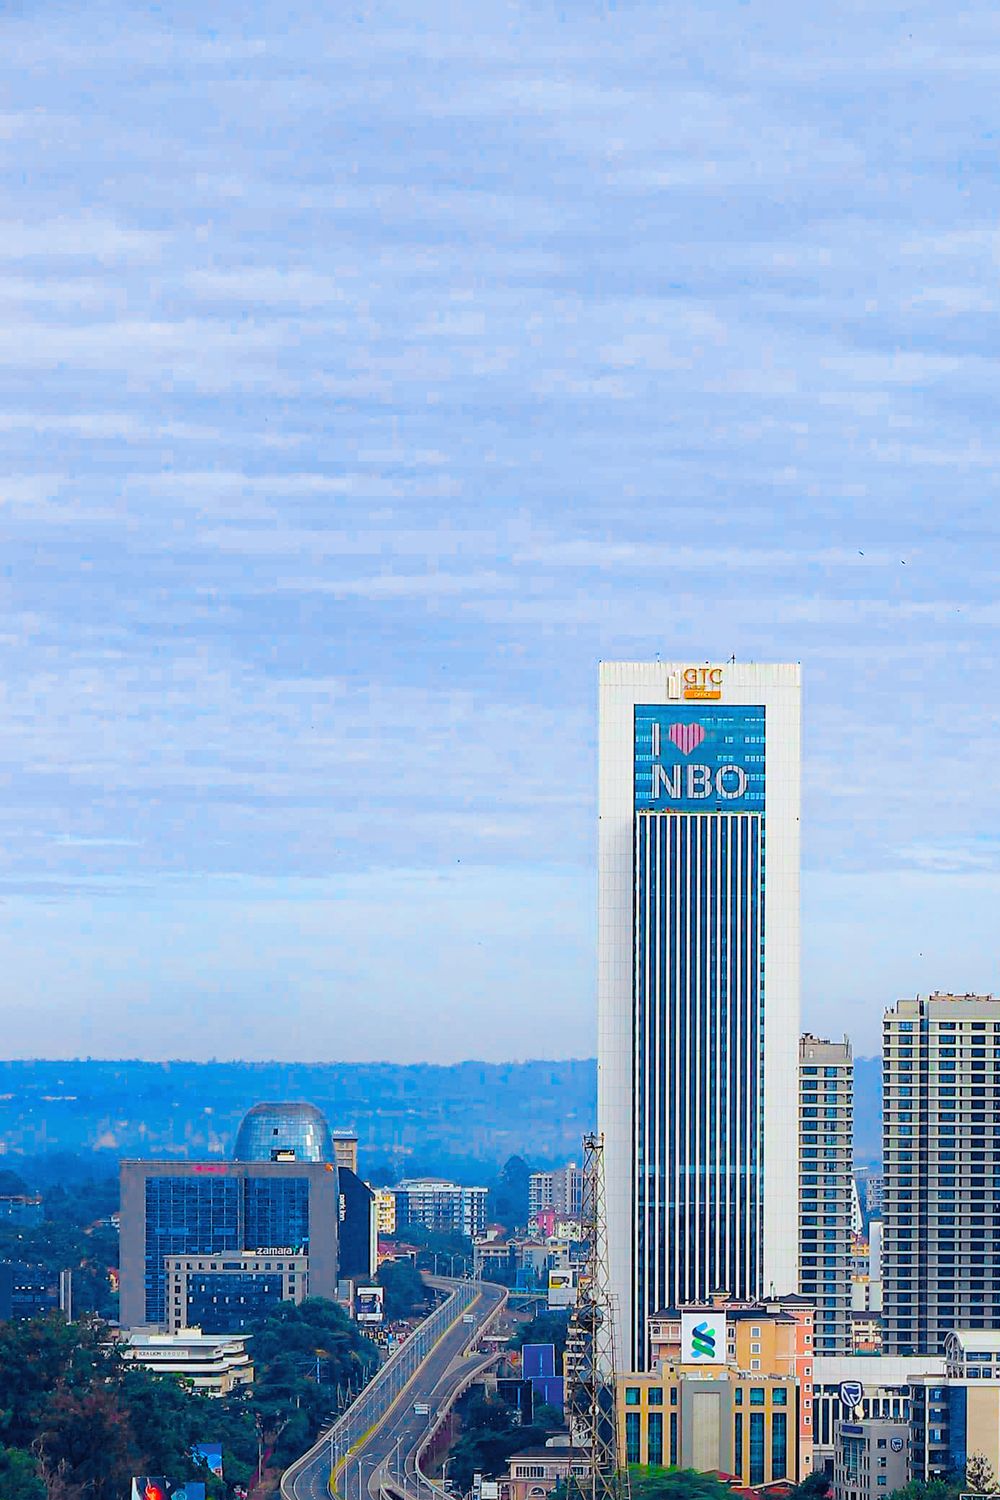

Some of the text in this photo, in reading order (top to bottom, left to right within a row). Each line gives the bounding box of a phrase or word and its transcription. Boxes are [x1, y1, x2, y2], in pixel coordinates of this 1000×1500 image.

[683, 668, 723, 684] GTC
[652, 723, 660, 756] I
[652, 764, 748, 800] NBO
